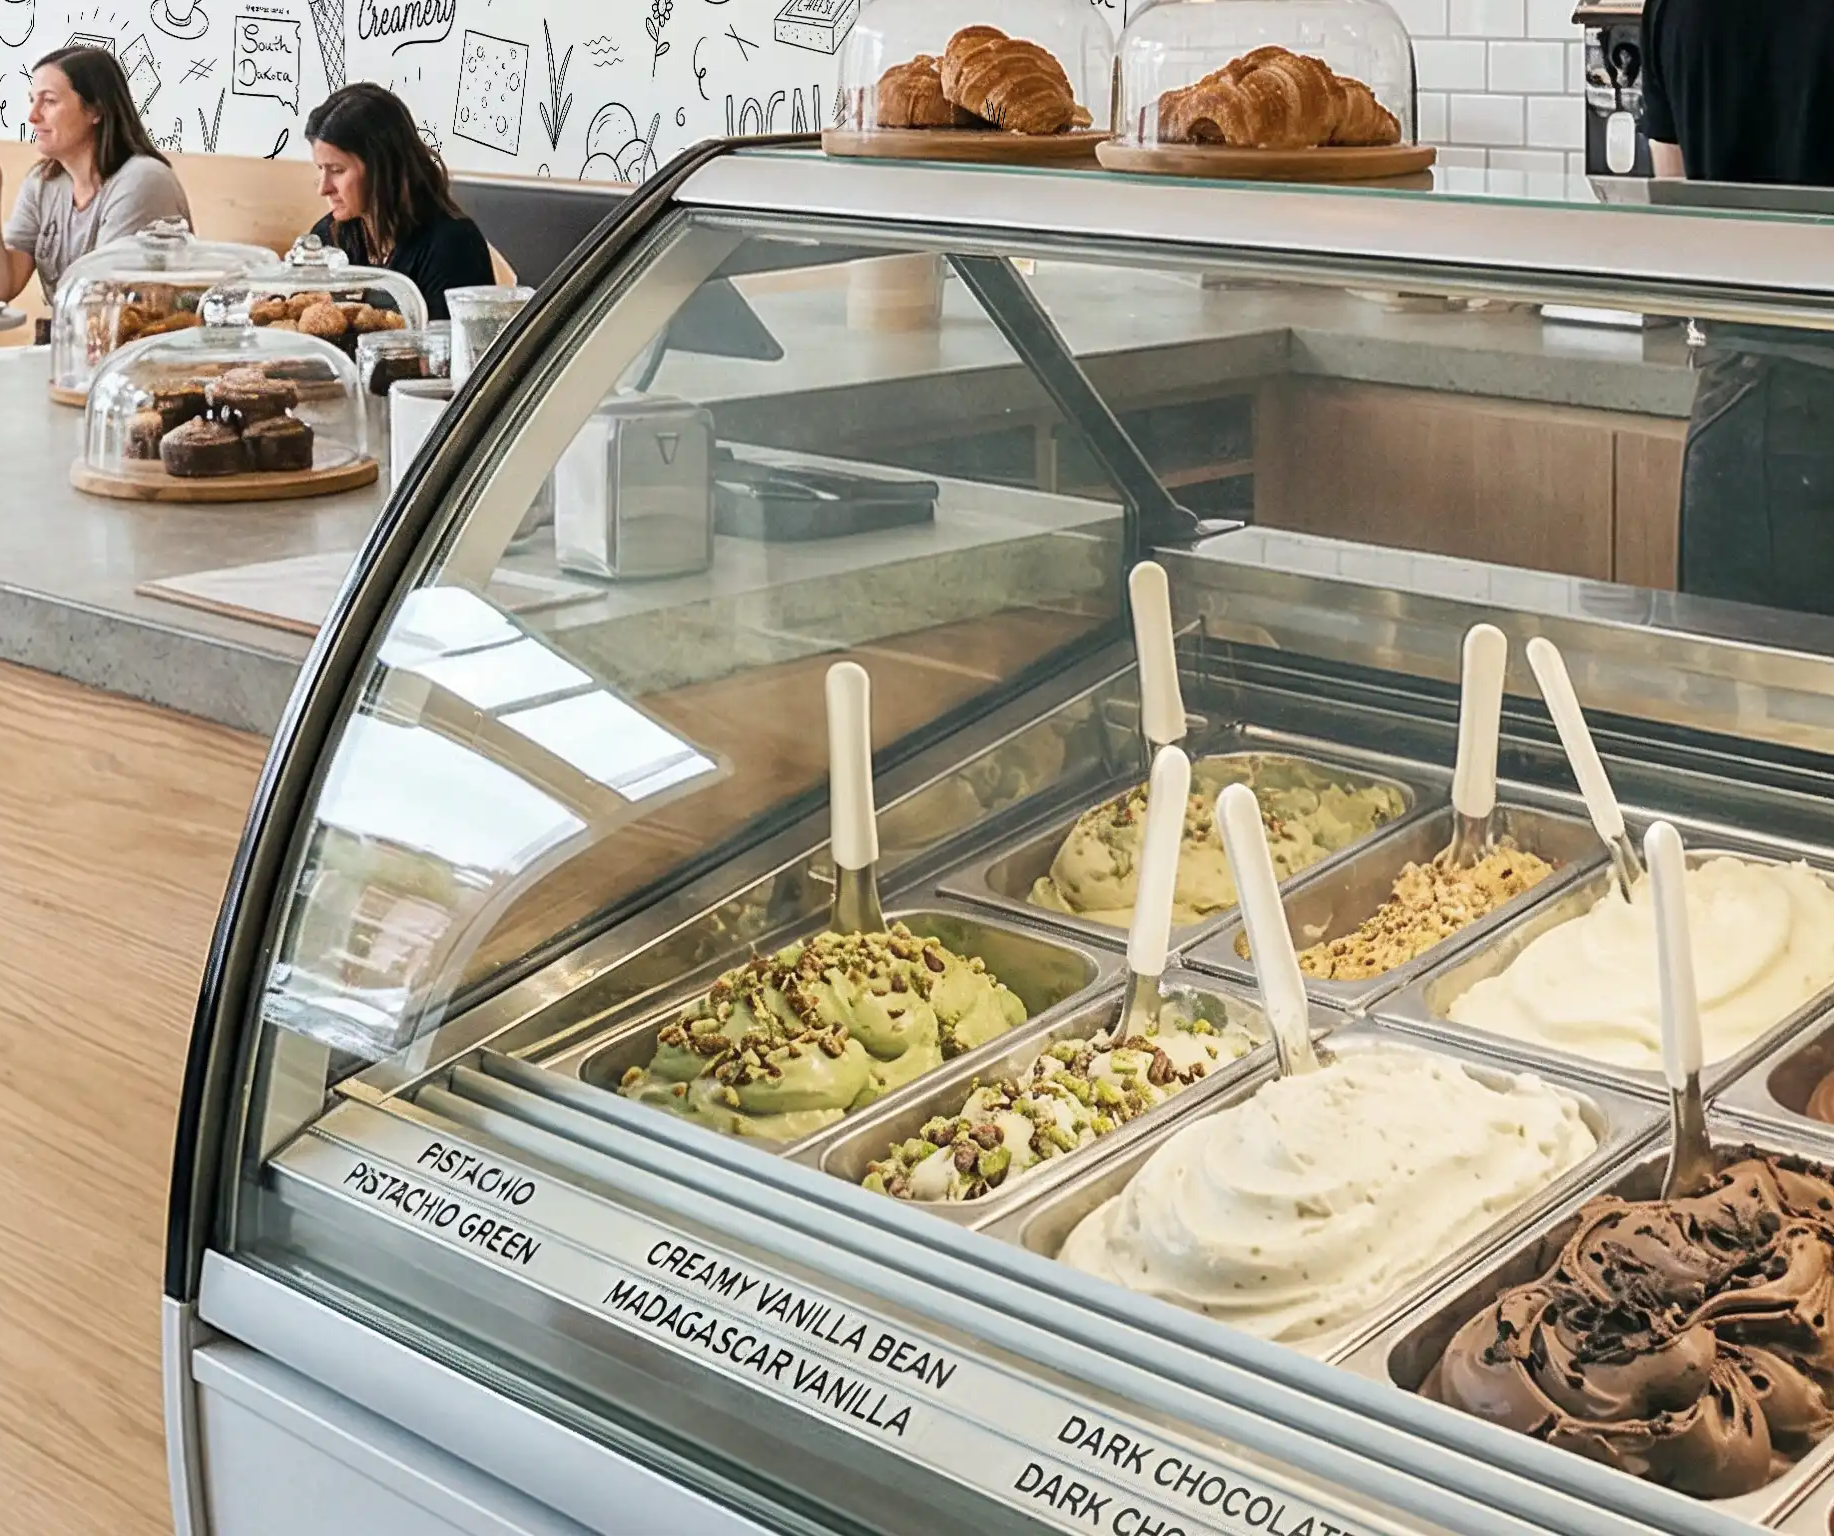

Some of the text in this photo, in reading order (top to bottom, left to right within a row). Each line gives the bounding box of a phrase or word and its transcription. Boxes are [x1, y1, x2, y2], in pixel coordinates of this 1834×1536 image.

[343, 1162, 542, 1265] PISTACHIO GREEN
[603, 1278, 913, 1437] MADAGASCAR VANILLA
[647, 1240, 958, 1389] CREAMY VANILLA BEAN
[1015, 1462, 1114, 1526] DARK
[1057, 1415, 1155, 1474] DARK
